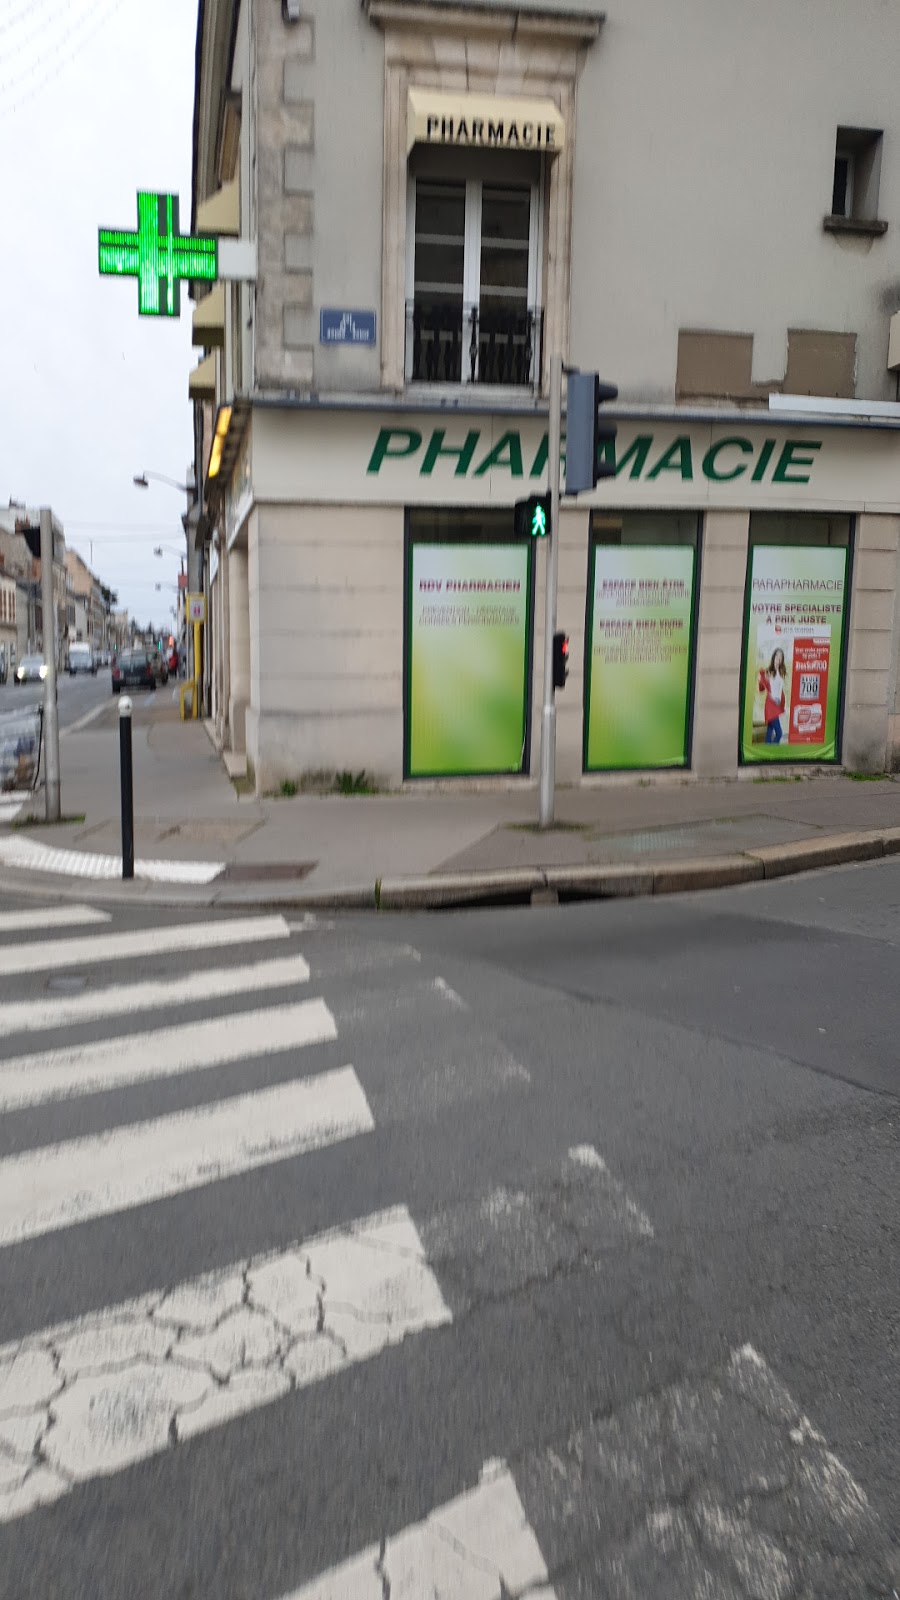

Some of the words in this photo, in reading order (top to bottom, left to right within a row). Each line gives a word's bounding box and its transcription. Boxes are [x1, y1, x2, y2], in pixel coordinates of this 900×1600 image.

[426, 113, 556, 148] PHARMACIE
[752, 577, 844, 592] PARAPHARMACIE
[751, 602, 782, 614] VOTRE
[775, 614, 796, 625] PRIX
[798, 614, 827, 625] JUSTE
[801, 681, 819, 693] 700
